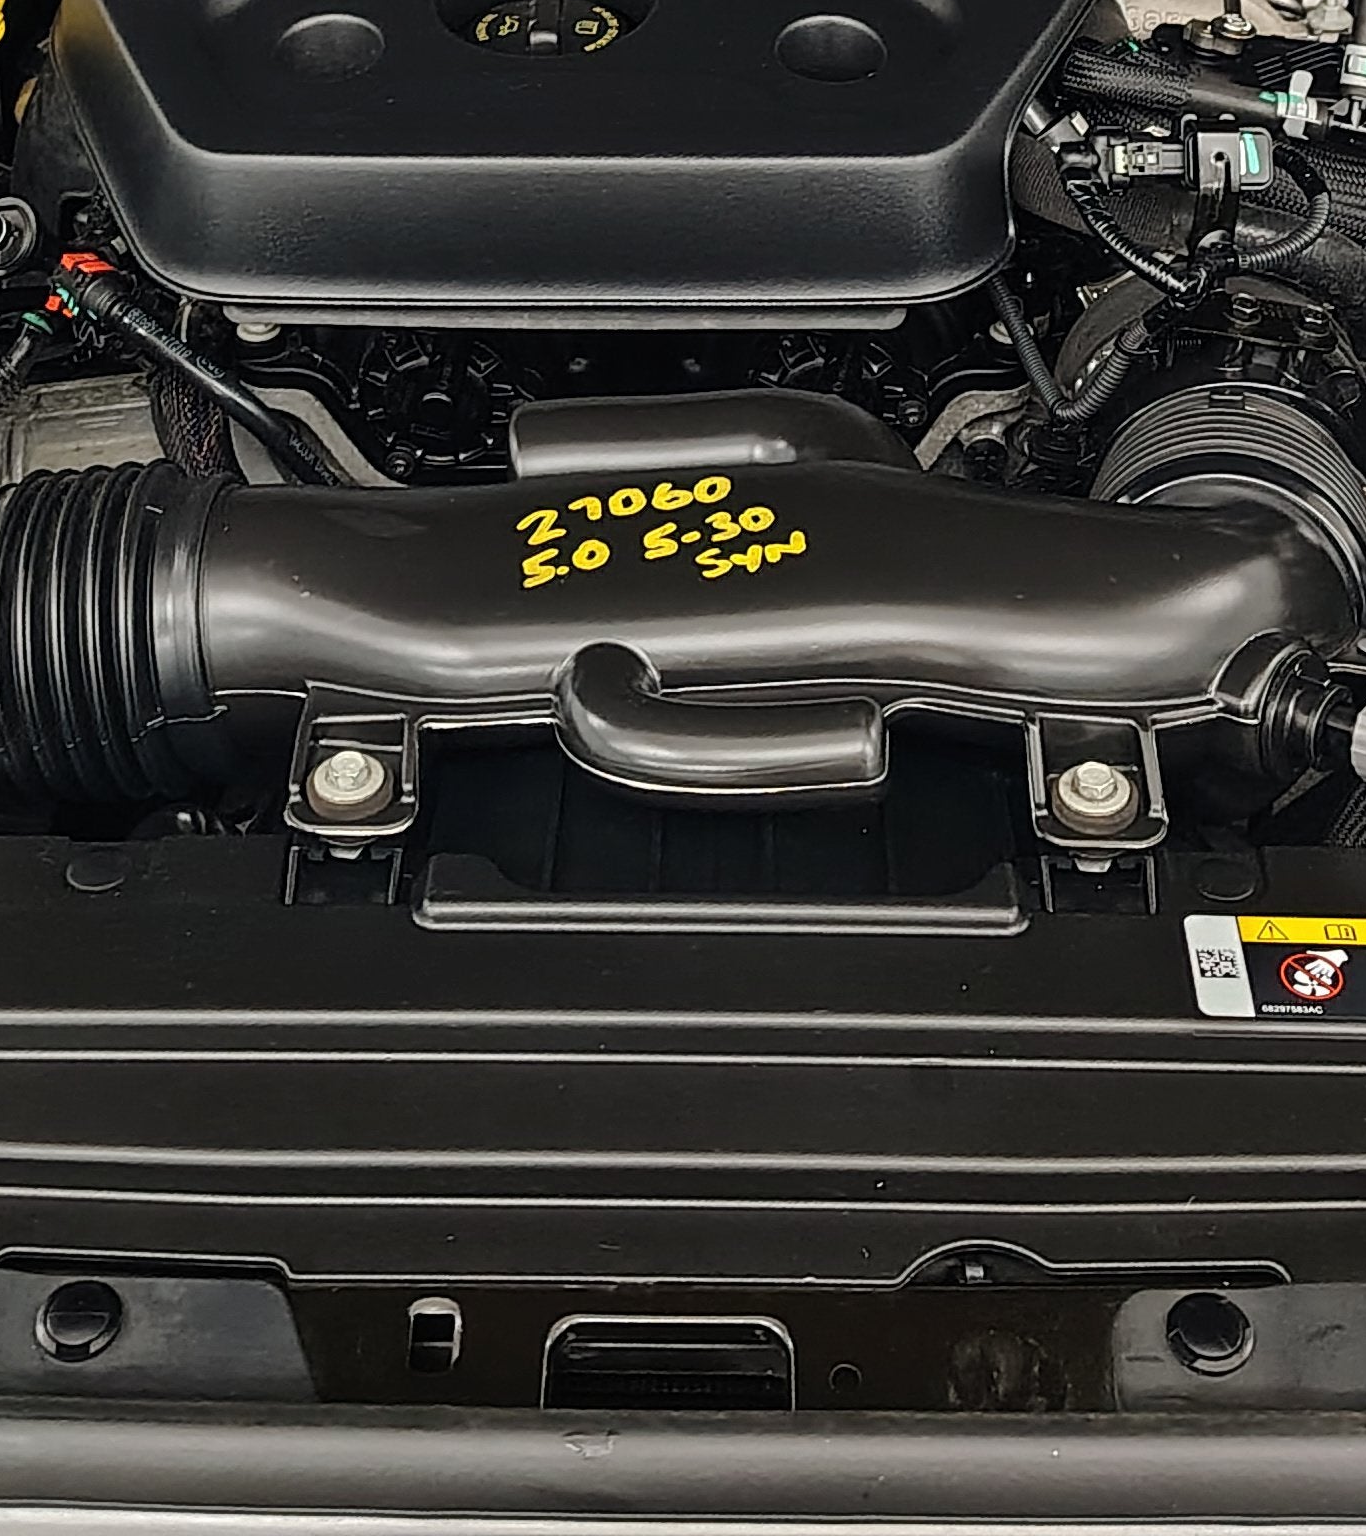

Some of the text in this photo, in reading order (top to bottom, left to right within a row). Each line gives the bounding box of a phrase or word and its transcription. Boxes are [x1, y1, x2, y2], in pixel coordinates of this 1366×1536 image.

[516, 475, 732, 546] 27060
[521, 506, 776, 589] 5.0 5-30
